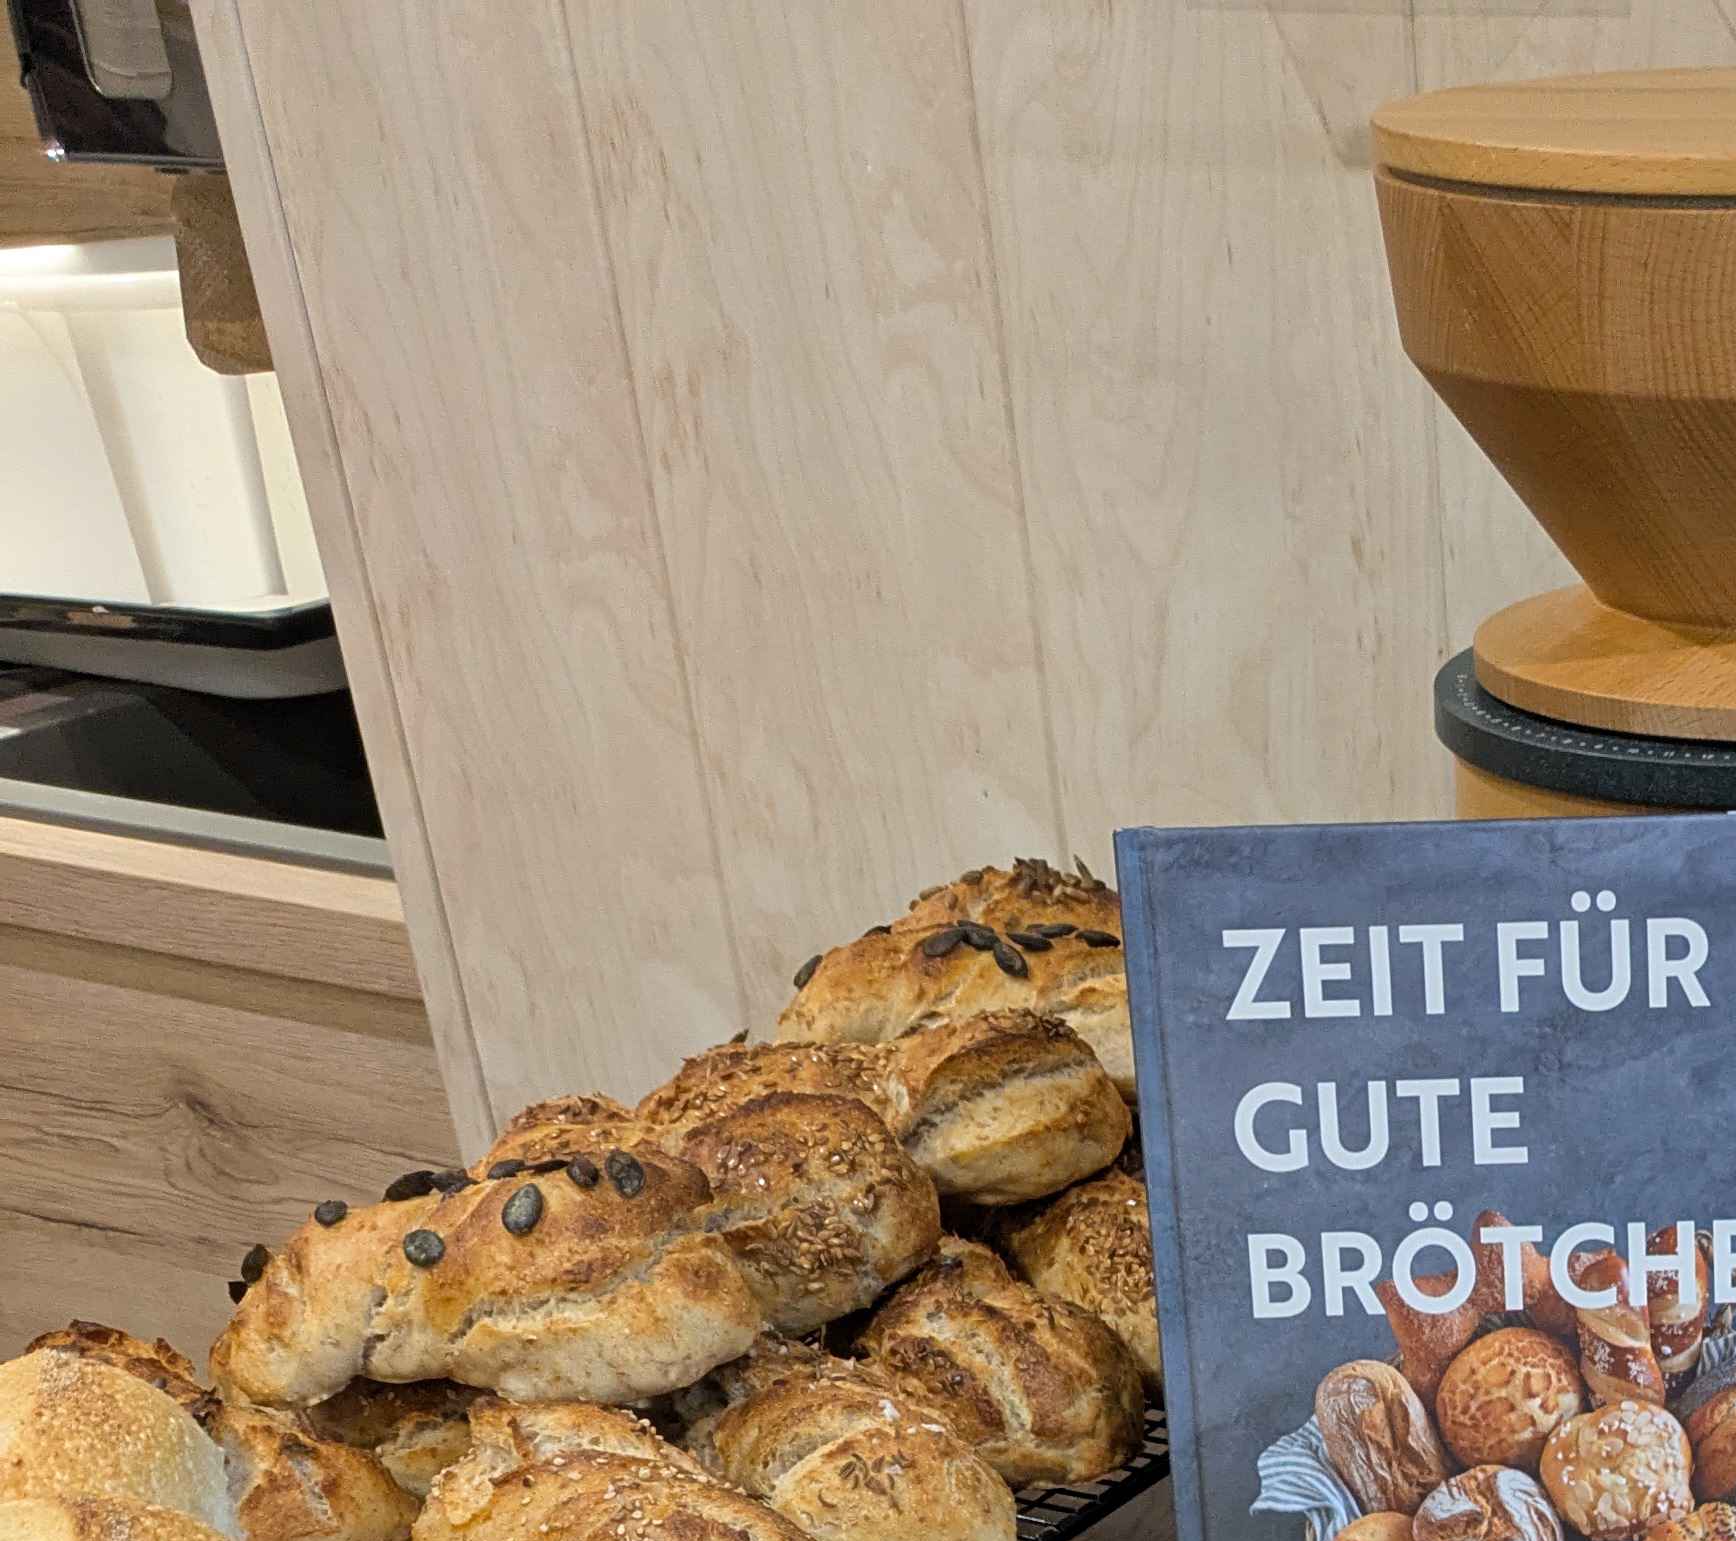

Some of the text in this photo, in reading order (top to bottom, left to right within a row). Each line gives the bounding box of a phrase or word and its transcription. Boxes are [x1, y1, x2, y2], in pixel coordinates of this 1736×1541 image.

[1221, 890, 1711, 1021] ZEIT FÜR
[1233, 1076, 1529, 1173] GUTE
